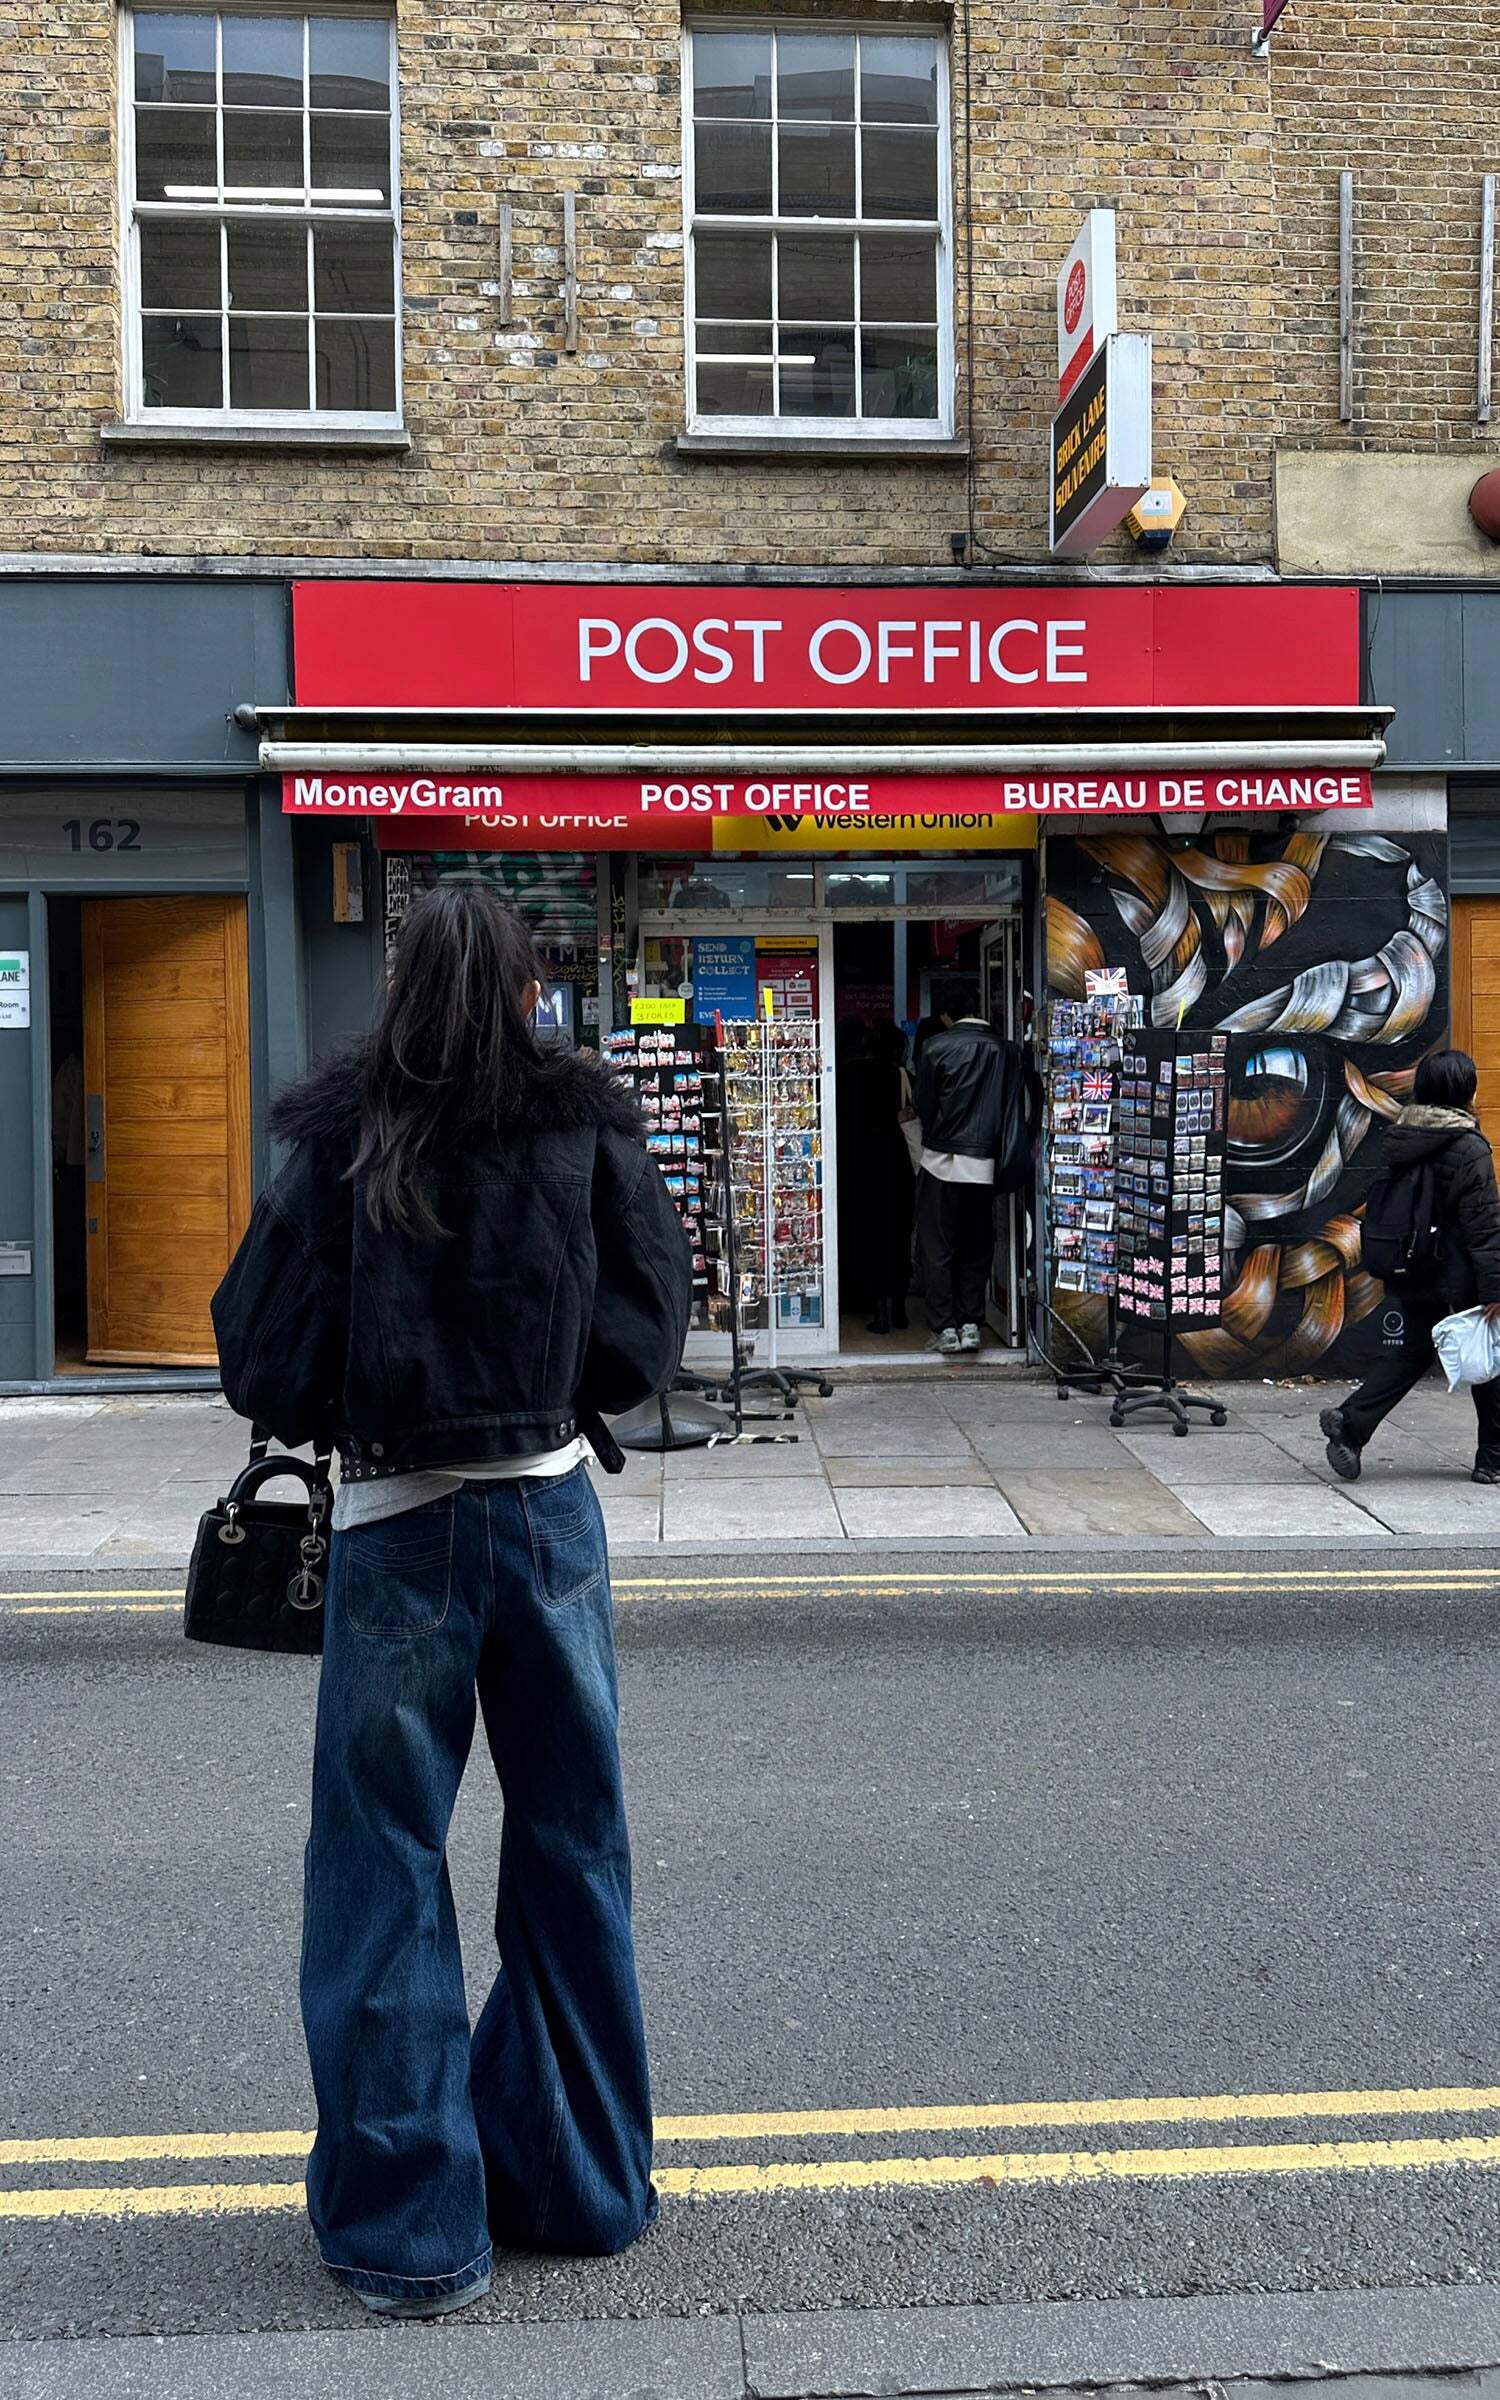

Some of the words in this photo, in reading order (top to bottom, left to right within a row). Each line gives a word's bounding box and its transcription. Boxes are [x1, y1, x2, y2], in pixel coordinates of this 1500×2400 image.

[1057, 420, 1081, 475] BRICK
[1083, 384, 1105, 439] LANE
[1055, 425, 1106, 515] SOUVENIRS
[578, 617, 783, 683] POST
[808, 618, 1088, 685] OFFICE
[293, 778, 504, 814] MoneyGram
[641, 783, 735, 812] POST
[744, 783, 871, 812] OFFICE
[1003, 781, 1147, 810] BUREAU
[1159, 780, 1206, 807] DE
[1214, 777, 1362, 806] CHANGE
[61, 819, 142, 852] 162
[697, 943, 728, 953] SEND
[698, 953, 744, 964] RETURN
[698, 965, 750, 976] COLLECT
